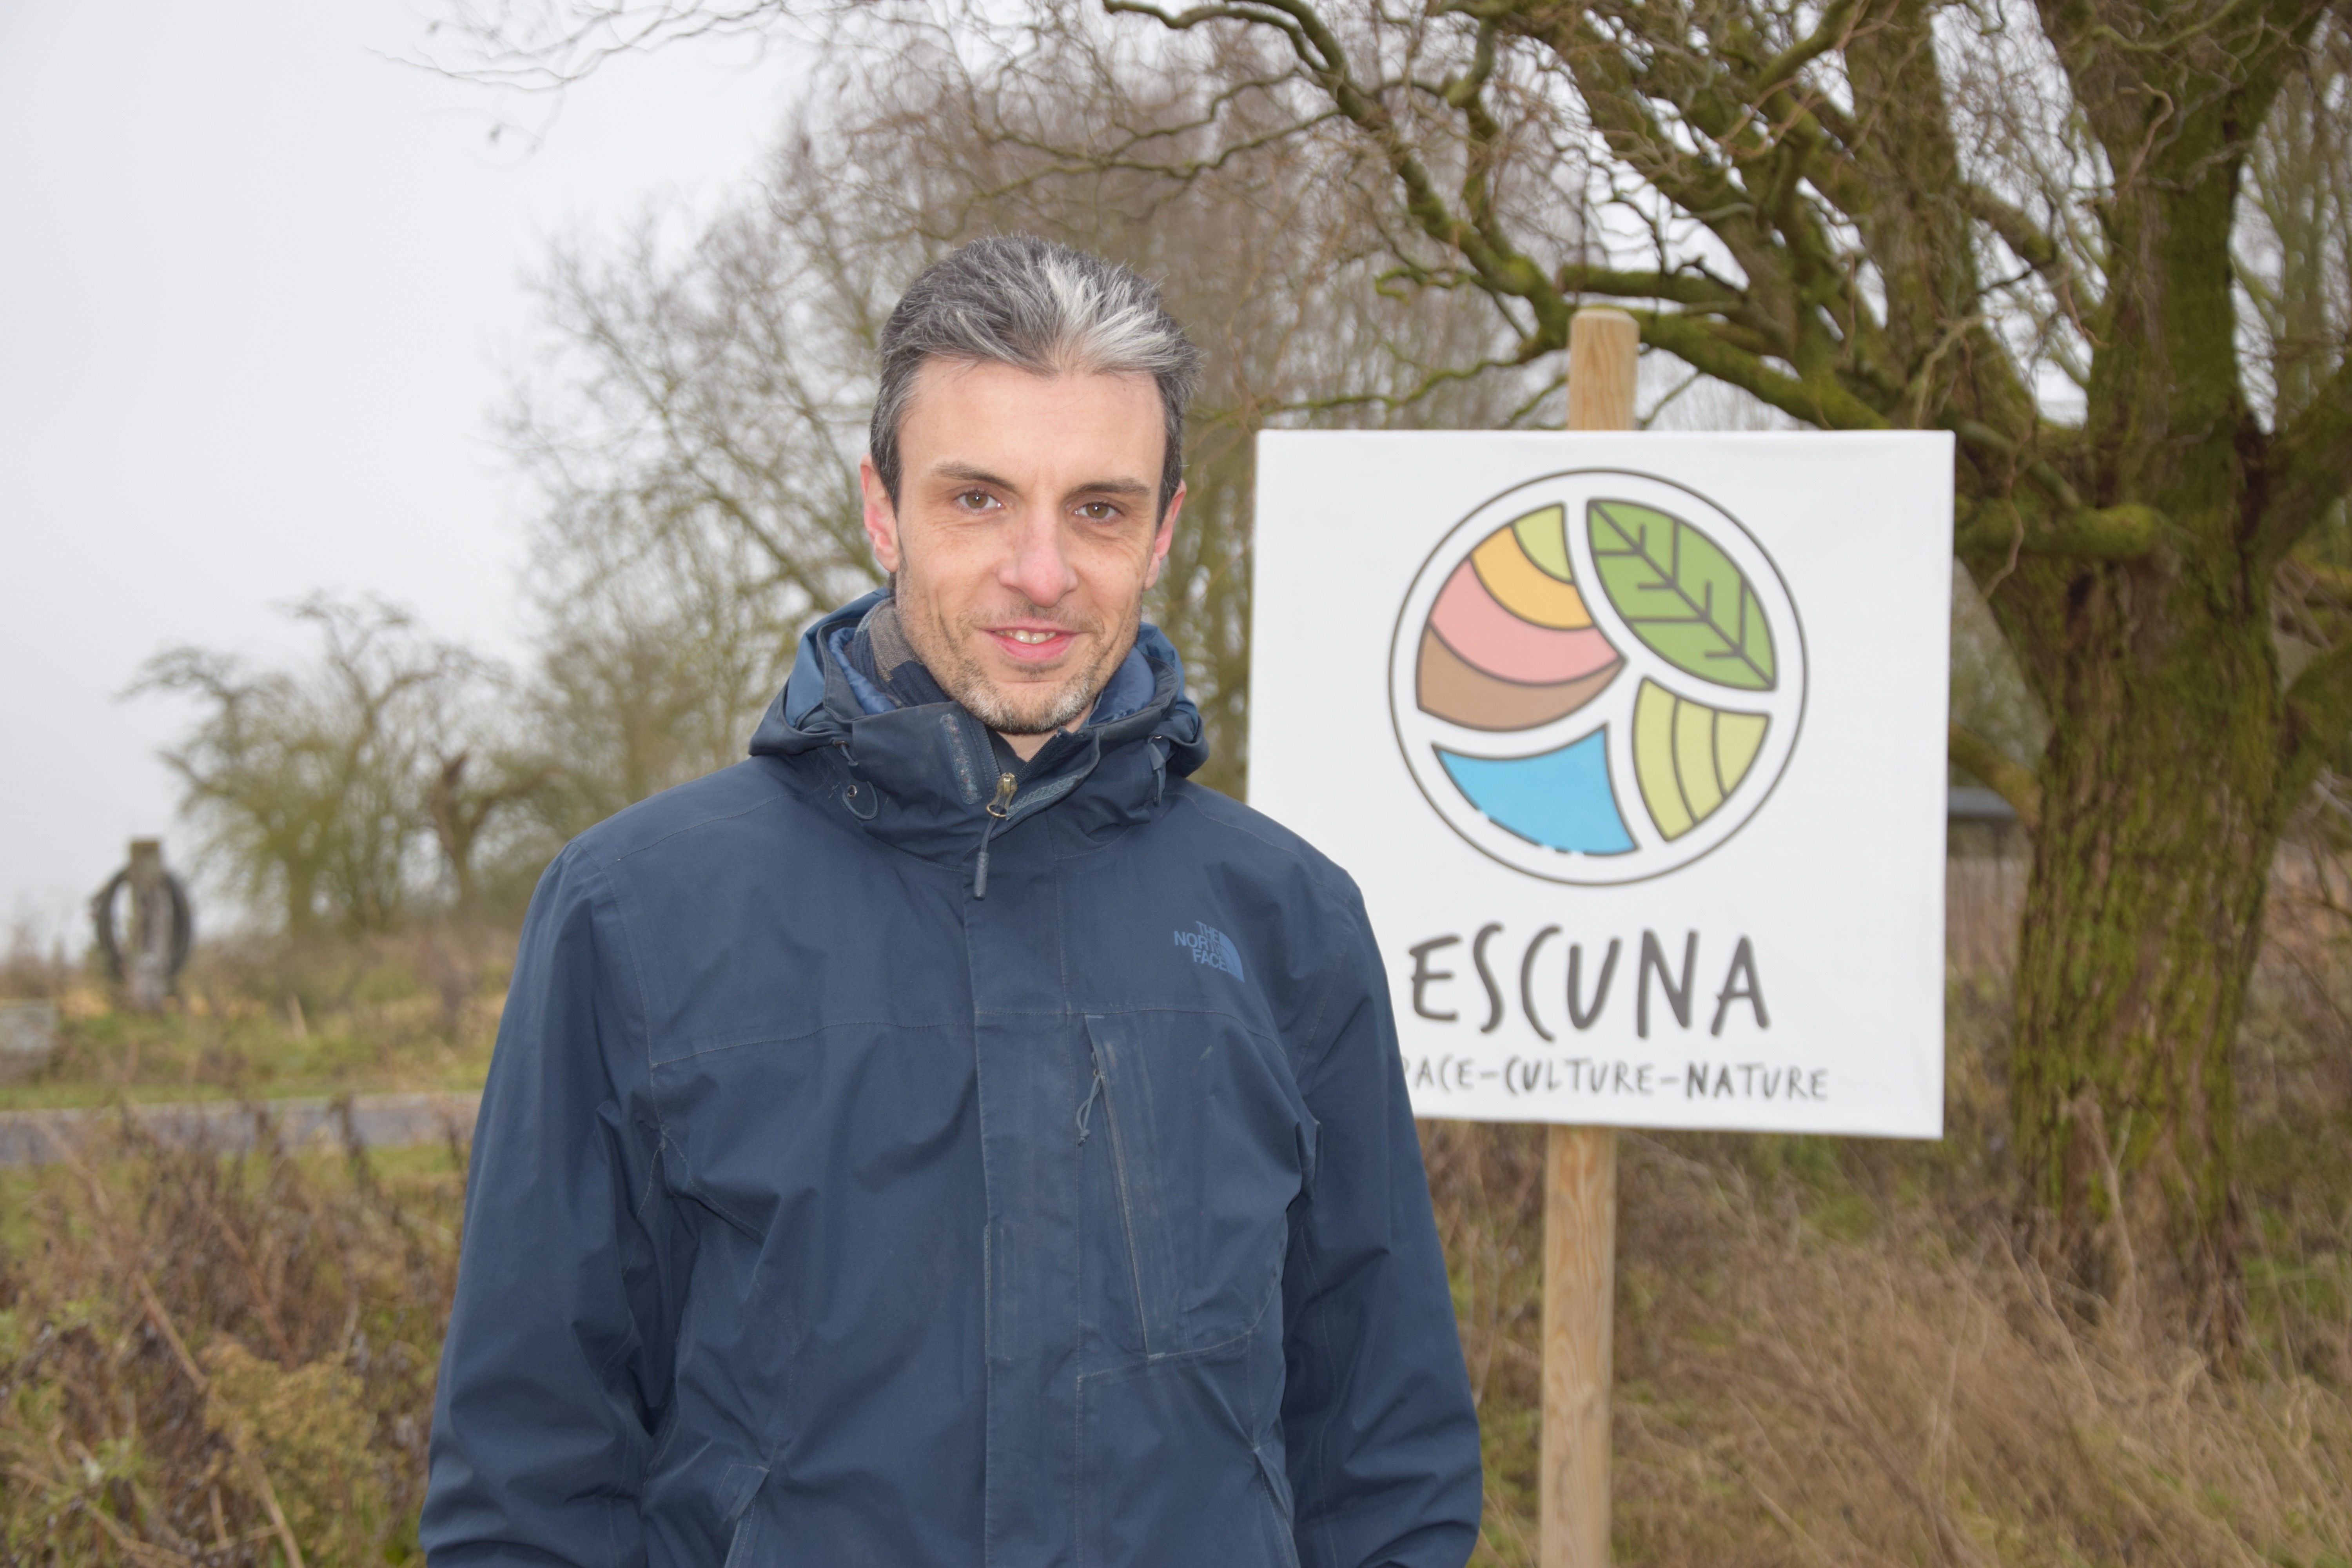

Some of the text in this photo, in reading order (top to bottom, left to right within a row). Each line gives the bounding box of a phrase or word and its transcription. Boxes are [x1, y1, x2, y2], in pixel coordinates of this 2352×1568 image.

[1174, 930, 1222, 955] NORTH
[1196, 920, 1220, 944] THE
[1192, 948, 1228, 971] FACE
[1406, 920, 1771, 1045] ESCUNA
